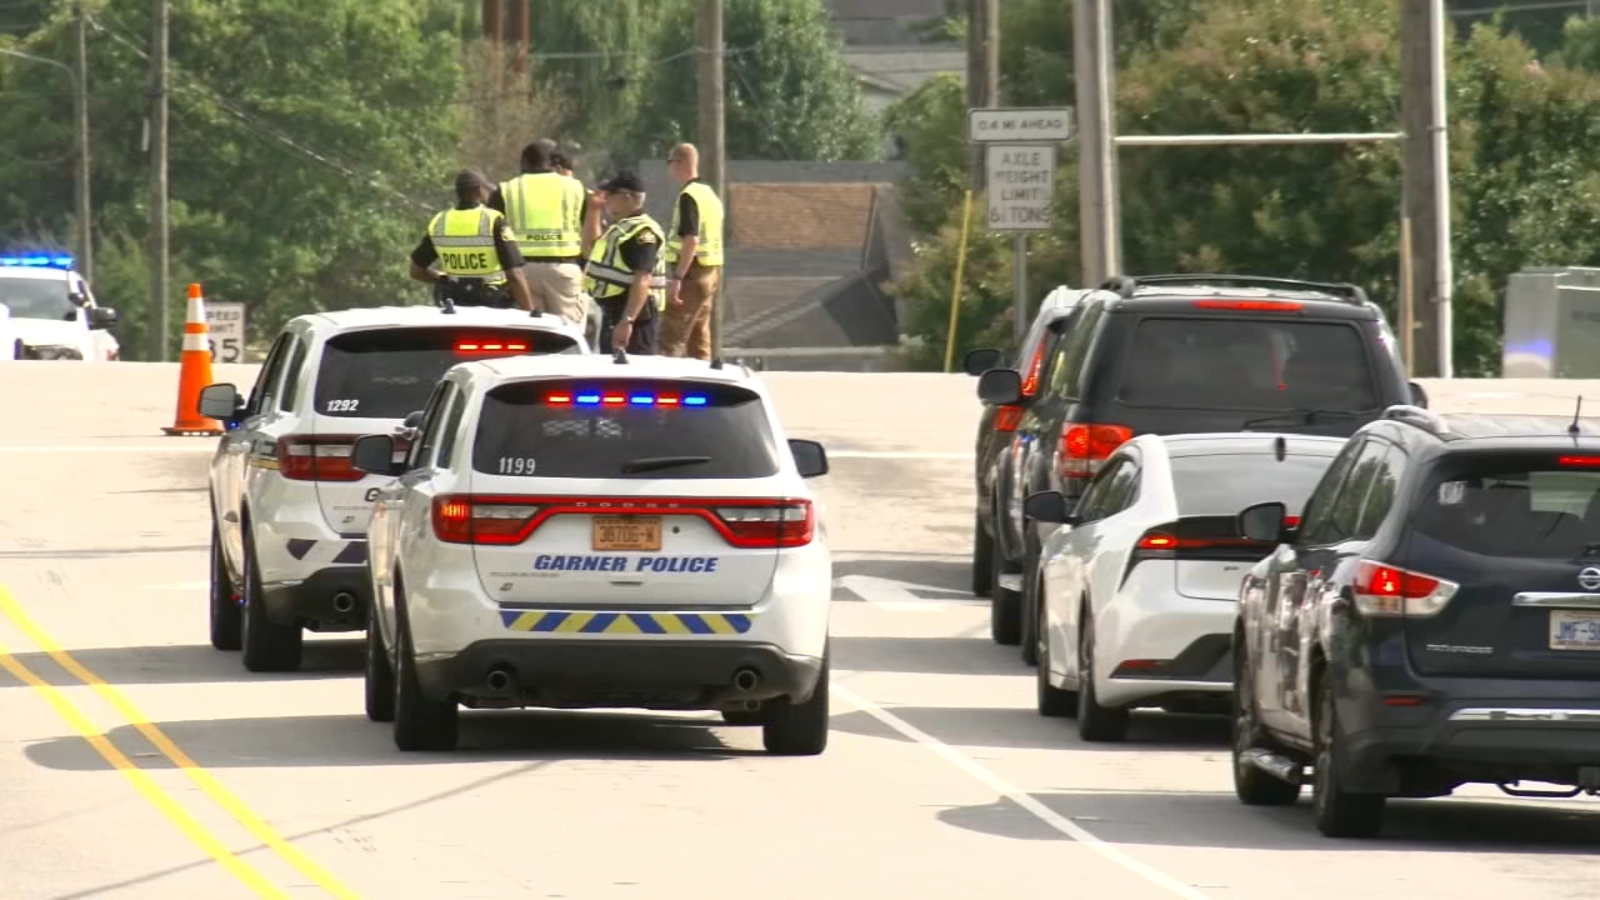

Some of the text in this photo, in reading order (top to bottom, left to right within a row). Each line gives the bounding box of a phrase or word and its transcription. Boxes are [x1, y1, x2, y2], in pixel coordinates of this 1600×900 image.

[1019, 118, 1062, 130] AHEAD
[1001, 151, 1041, 166] AXLE
[1001, 188, 1039, 201] LIMIT
[1009, 206, 1051, 223] TONS
[442, 252, 487, 270] POLICE
[205, 311, 241, 321] PEED
[326, 399, 360, 412] 1292
[498, 457, 537, 475] 1199
[534, 554, 718, 573] GARNER POLICE
